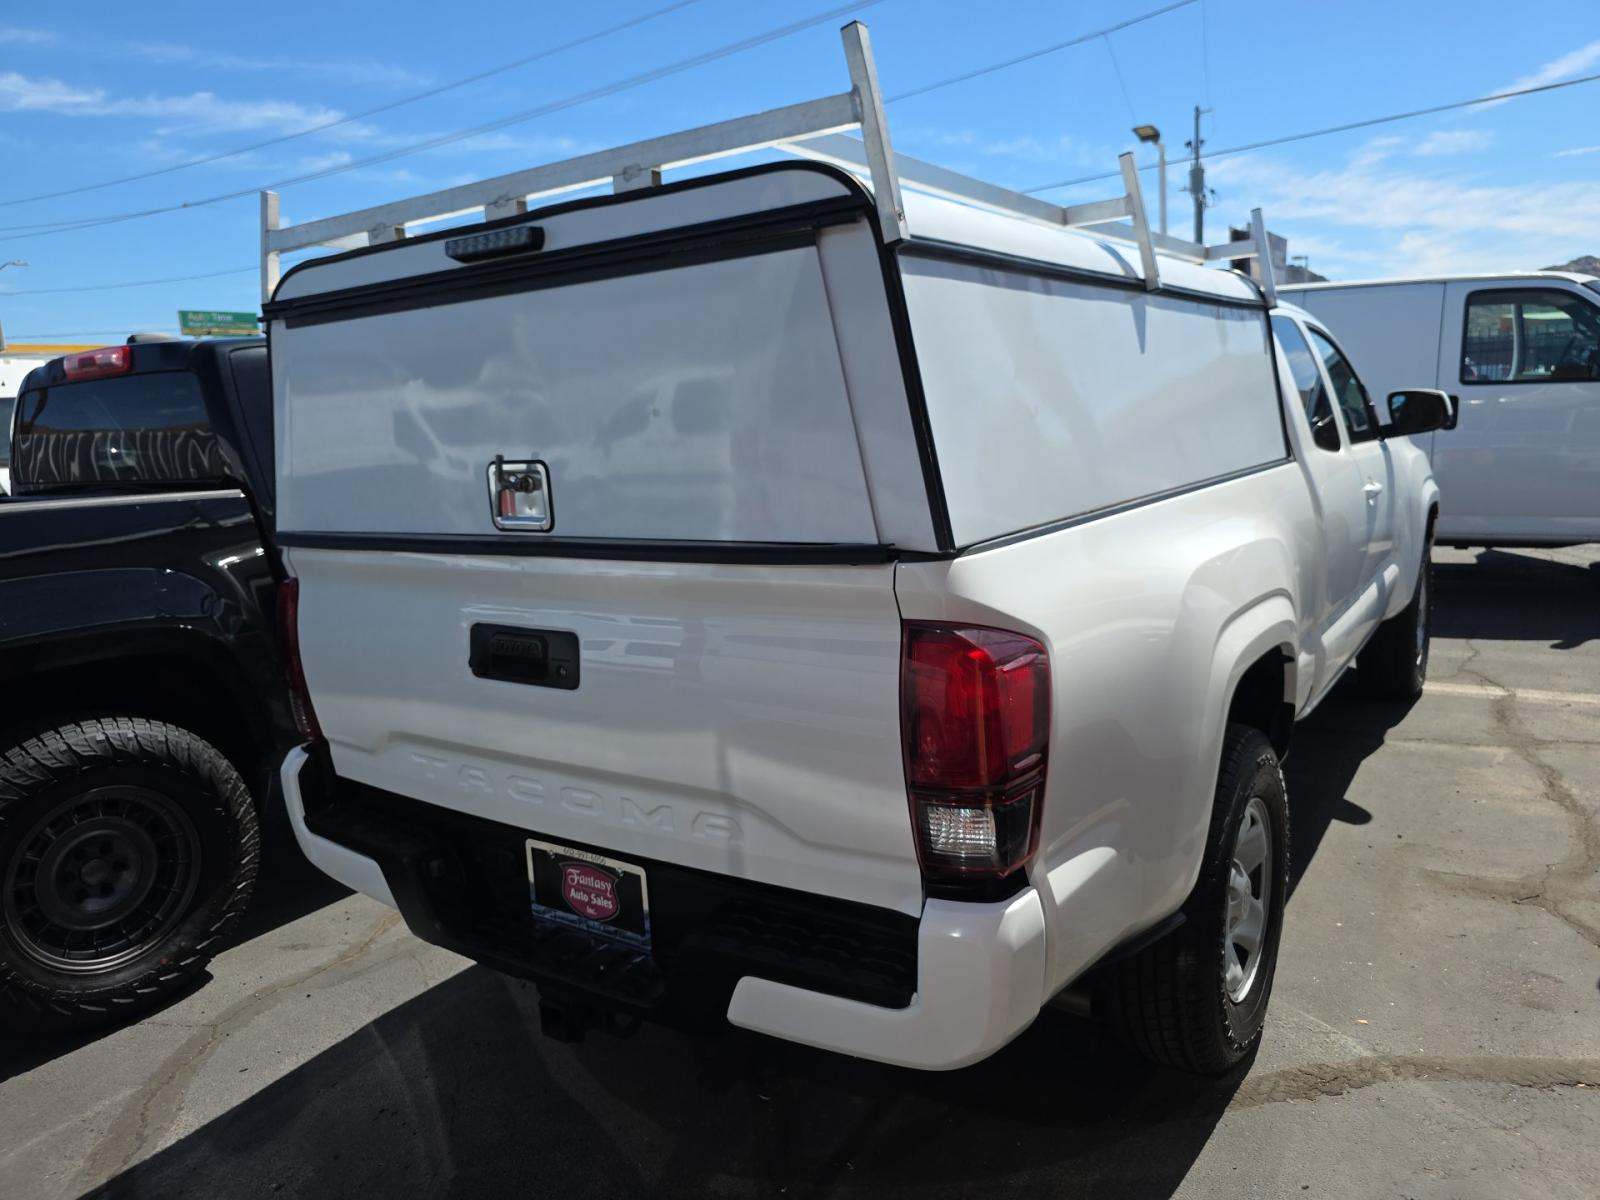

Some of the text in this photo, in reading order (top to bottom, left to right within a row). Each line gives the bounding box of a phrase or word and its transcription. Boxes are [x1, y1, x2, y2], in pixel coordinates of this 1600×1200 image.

[410, 752, 745, 847] TACOMA
[566, 868, 611, 898] Fantasy
[570, 888, 613, 909] Auto Sales
